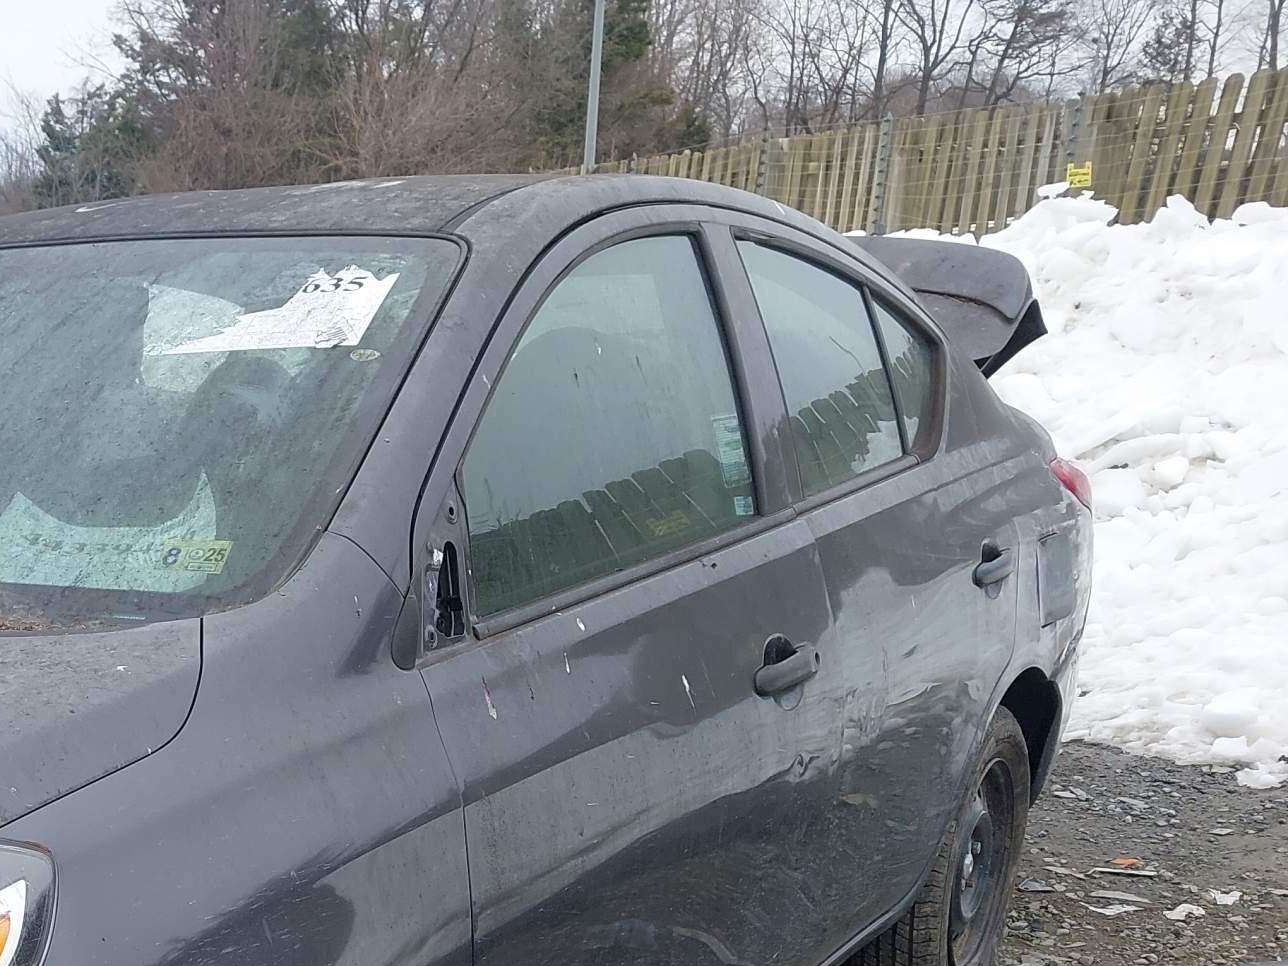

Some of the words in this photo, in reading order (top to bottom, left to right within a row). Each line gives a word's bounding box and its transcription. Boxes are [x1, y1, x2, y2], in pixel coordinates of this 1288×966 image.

[302, 276, 366, 294] 635
[162, 547, 182, 568] 8
[202, 547, 228, 563] 25
